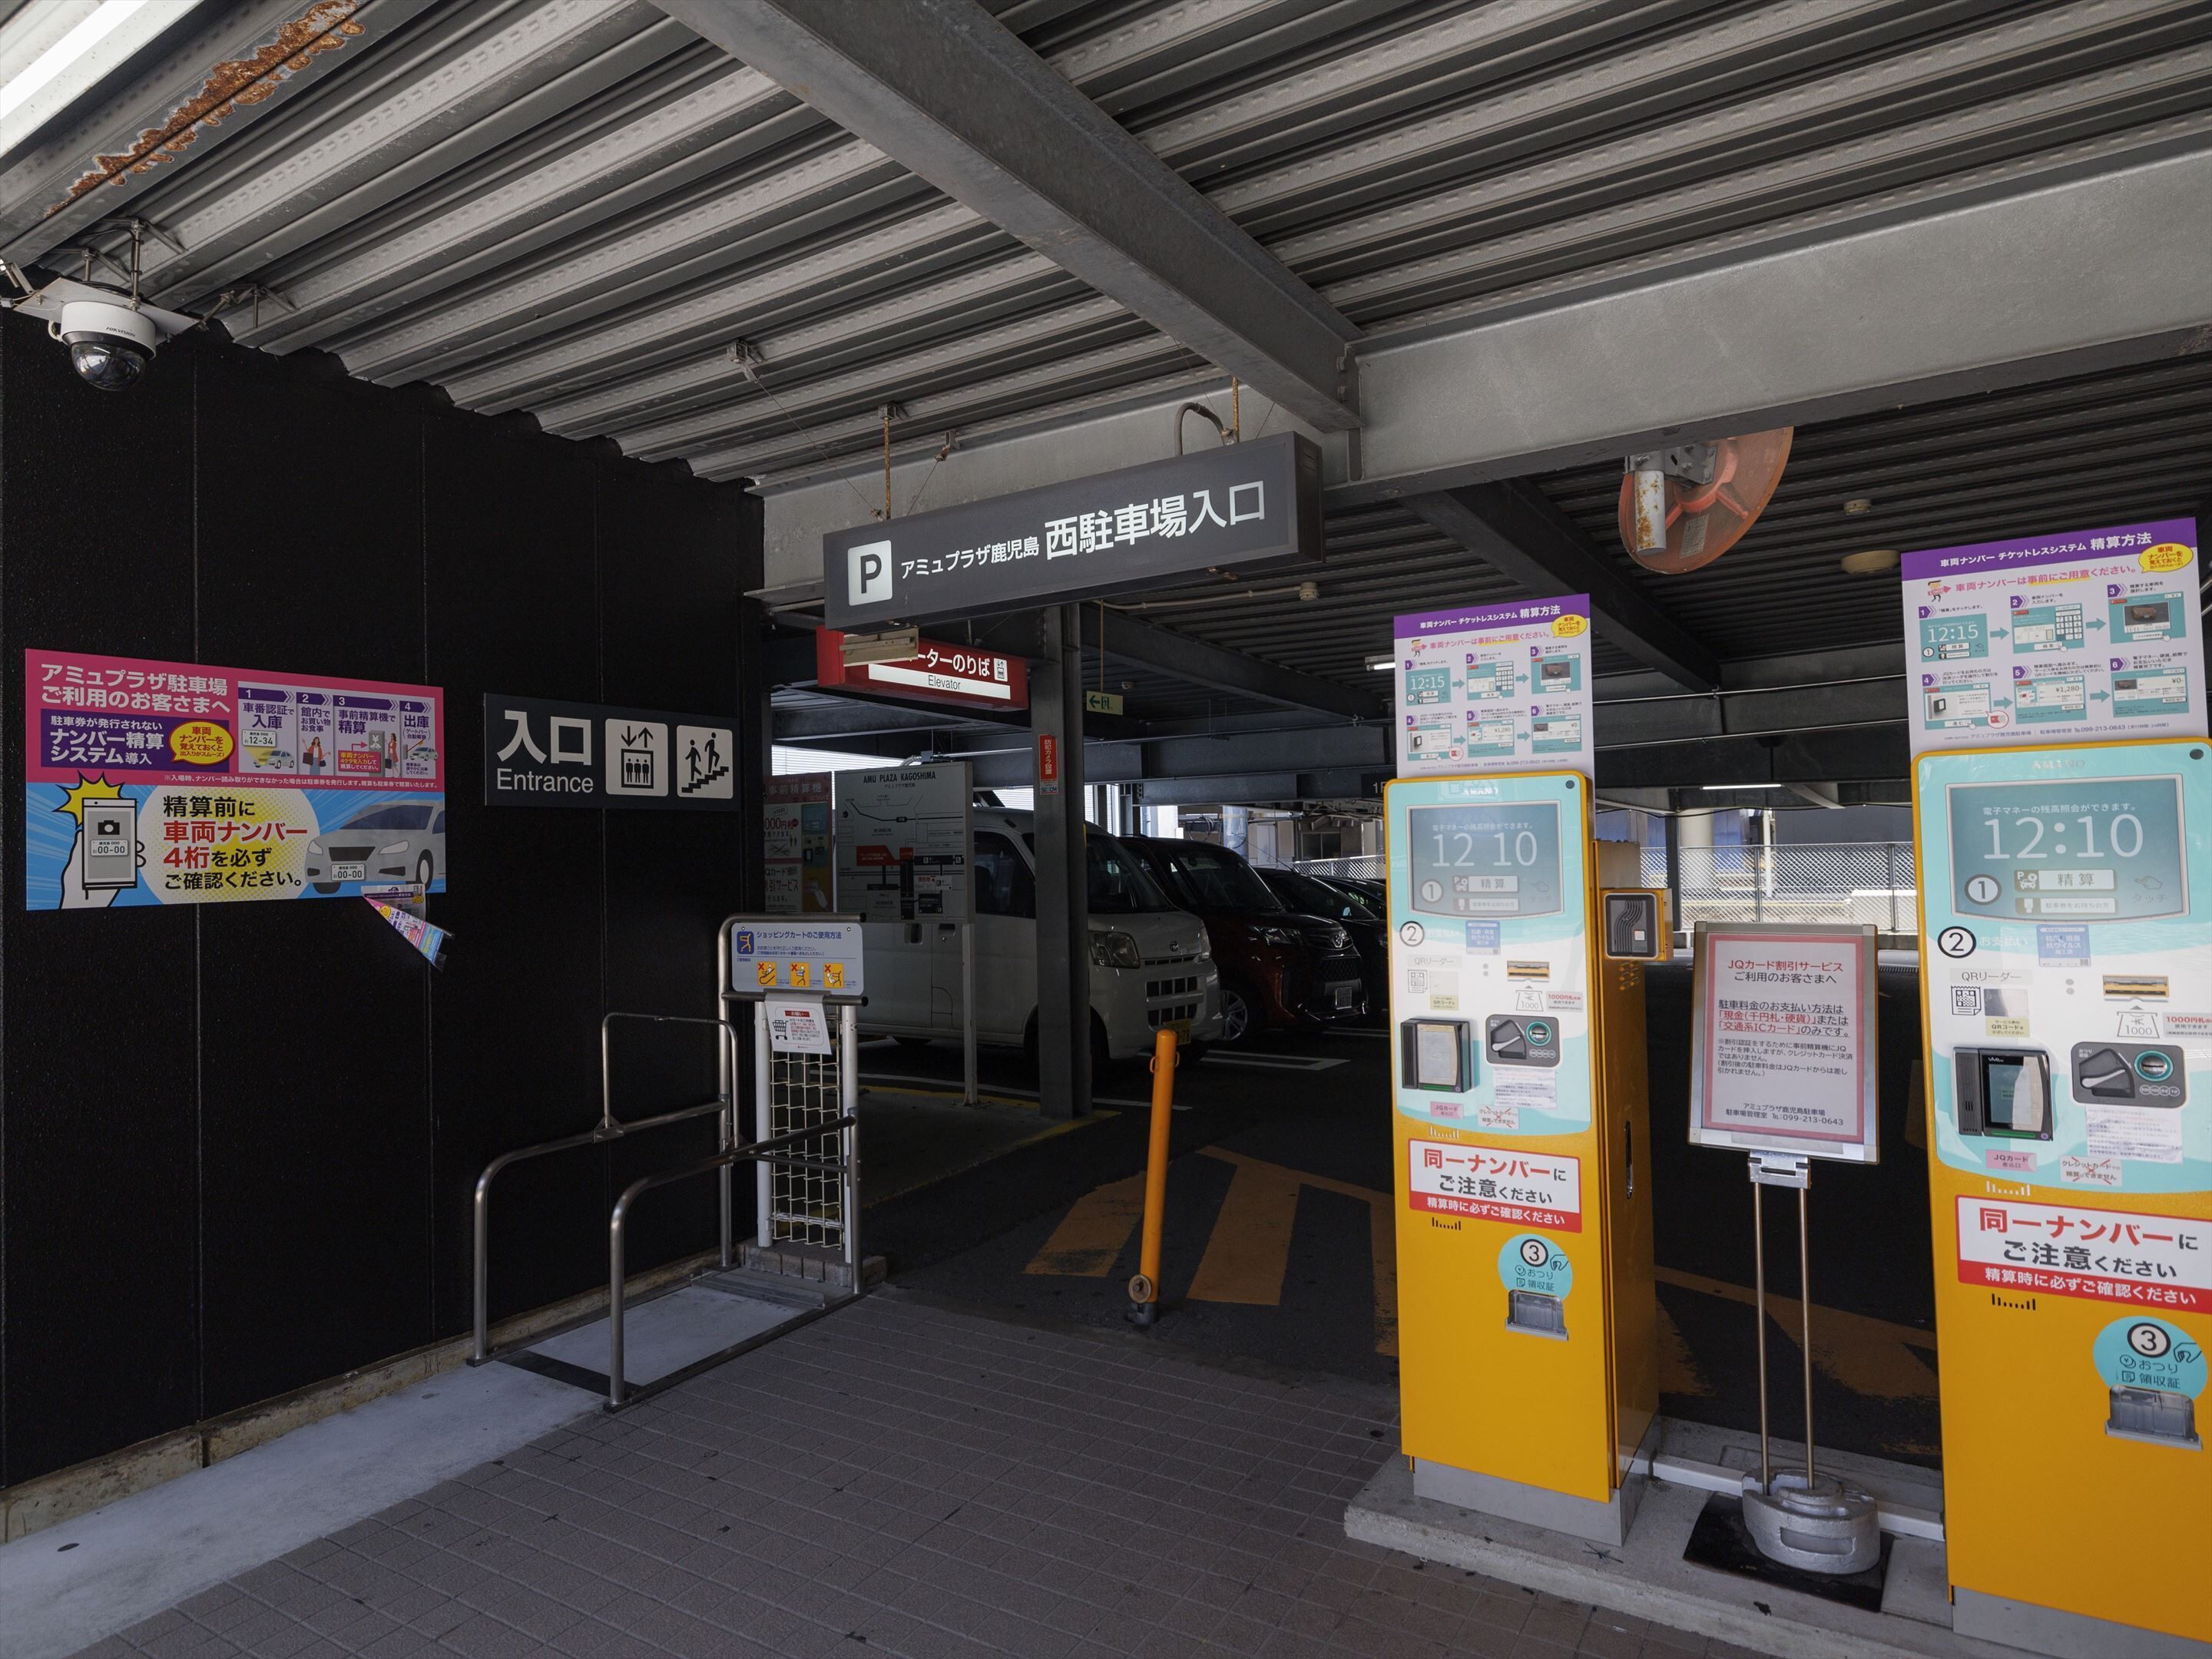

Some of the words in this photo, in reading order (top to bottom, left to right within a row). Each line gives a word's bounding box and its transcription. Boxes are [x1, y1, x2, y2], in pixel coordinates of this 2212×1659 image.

[106, 326, 136, 338] HIKVISION
[901, 536, 1040, 579] アミュプラザ鹿児島
[1045, 480, 1265, 561] 西駐車場入口
[1940, 553, 1995, 568] 車両ナンバー
[1998, 542, 2087, 561] チケットレスシステム
[2090, 532, 2152, 551] 精算方法
[2148, 551, 2183, 560] ナンバーを
[860, 554, 882, 594] P
[1955, 565, 2136, 592] 車両ナンバーは事前にご用意ください。
[1420, 619, 1457, 629] 車両ナンバー
[1459, 611, 1518, 624] チケットレスシステム
[1519, 605, 1561, 619] 精算方法
[1430, 631, 1550, 649] 車両ナンバーは事前にご用意ください。
[1928, 624, 1979, 643] 12:15
[917, 647, 990, 677] ーターのりば
[41, 664, 228, 696] アミュプラザ駐車場
[928, 674, 961, 690] Elevator
[1410, 675, 1445, 690] 12:15
[41, 685, 230, 714] ご利用のお客さまへ
[245, 690, 252, 698] 1
[302, 694, 309, 703] 2
[243, 702, 295, 715] 車番認証で
[339, 697, 346, 706] 3
[300, 707, 331, 719] 館内で
[338, 709, 396, 723] 事前精算機で
[51, 715, 163, 730] 駐車券が発行されない
[252, 714, 283, 730] 入庫
[300, 717, 331, 726] お買い物
[300, 724, 324, 733] お食事
[338, 721, 366, 735] 精算
[404, 716, 429, 728] 出庫
[192, 727, 212, 736] 車両
[496, 709, 594, 766] 入口
[50, 728, 164, 750] ナンバー精算
[179, 735, 224, 745] ナンバーを
[249, 736, 273, 745] 12-34
[180, 743, 224, 752] 覚えておくと
[51, 745, 152, 765] システム導入
[1044, 739, 1052, 775] 防犯カメラ設置
[496, 769, 594, 794] Entrance
[863, 775, 876, 783] AMU
[879, 773, 897, 783] PLAZA
[900, 771, 936, 780] KAGOSHIMA
[770, 783, 823, 796] 事前精算機
[163, 796, 255, 818] 精算前に
[1982, 803, 2137, 816] 電子マネーの残高照会ができます。
[164, 820, 307, 844] 車両ナンバー
[1984, 813, 2144, 859] 12:10
[98, 845, 125, 854] 00-00
[164, 846, 273, 869] 4桁を必ず
[337, 869, 363, 879] 00-00
[765, 868, 786, 877] Qカード
[164, 871, 303, 890] ご確認ください。
[1480, 878, 1506, 889] 精算
[2057, 873, 2095, 887] 精算
[757, 931, 842, 939] ショッピングカートのご使用方法
[1414, 957, 1454, 965] QRリーダー
[1728, 959, 1843, 972] JQカード割引サービス
[1734, 972, 1836, 985] ご利用のお客さまへ
[1961, 972, 2022, 982] QRリーダー
[1521, 1001, 1539, 1010] 1000
[1718, 999, 1844, 1014] 駐車料金のお支払い方法は
[1719, 1022, 1849, 1038] 「交通系ICカード」のみです。
[2124, 1025, 2152, 1035] 1000
[1718, 1038, 1846, 1052] ※割引認証をするために事前精算機にJQ
[1718, 1046, 1853, 1060] カードを挿入しますが、クレジットカード決済
[1718, 1053, 1767, 1062] ではありません。
[1717, 1060, 1848, 1075] (割引後の駐車料金はJQカードからは差し
[1726, 1108, 1767, 1119] 駐車場管理室
[1743, 1103, 1825, 1116] アミュプラザ鹿児島駐車場
[1424, 1147, 1567, 1182] 同一ナンバーに
[1439, 1174, 1553, 1204] ご注意ください
[1426, 1197, 1565, 1225] 精算時に必ずご確認ください
[1979, 1207, 2199, 1251] 同一ナンバーに
[2003, 1240, 2177, 1279] ご注意ください
[1528, 1269, 1554, 1280] おつり
[1528, 1279, 1555, 1292] 領収証
[1985, 1267, 2197, 1305] 精算時に必ずご確認ください
[2138, 1360, 2179, 1373] おつり
[2139, 1373, 2181, 1389] 領収証
